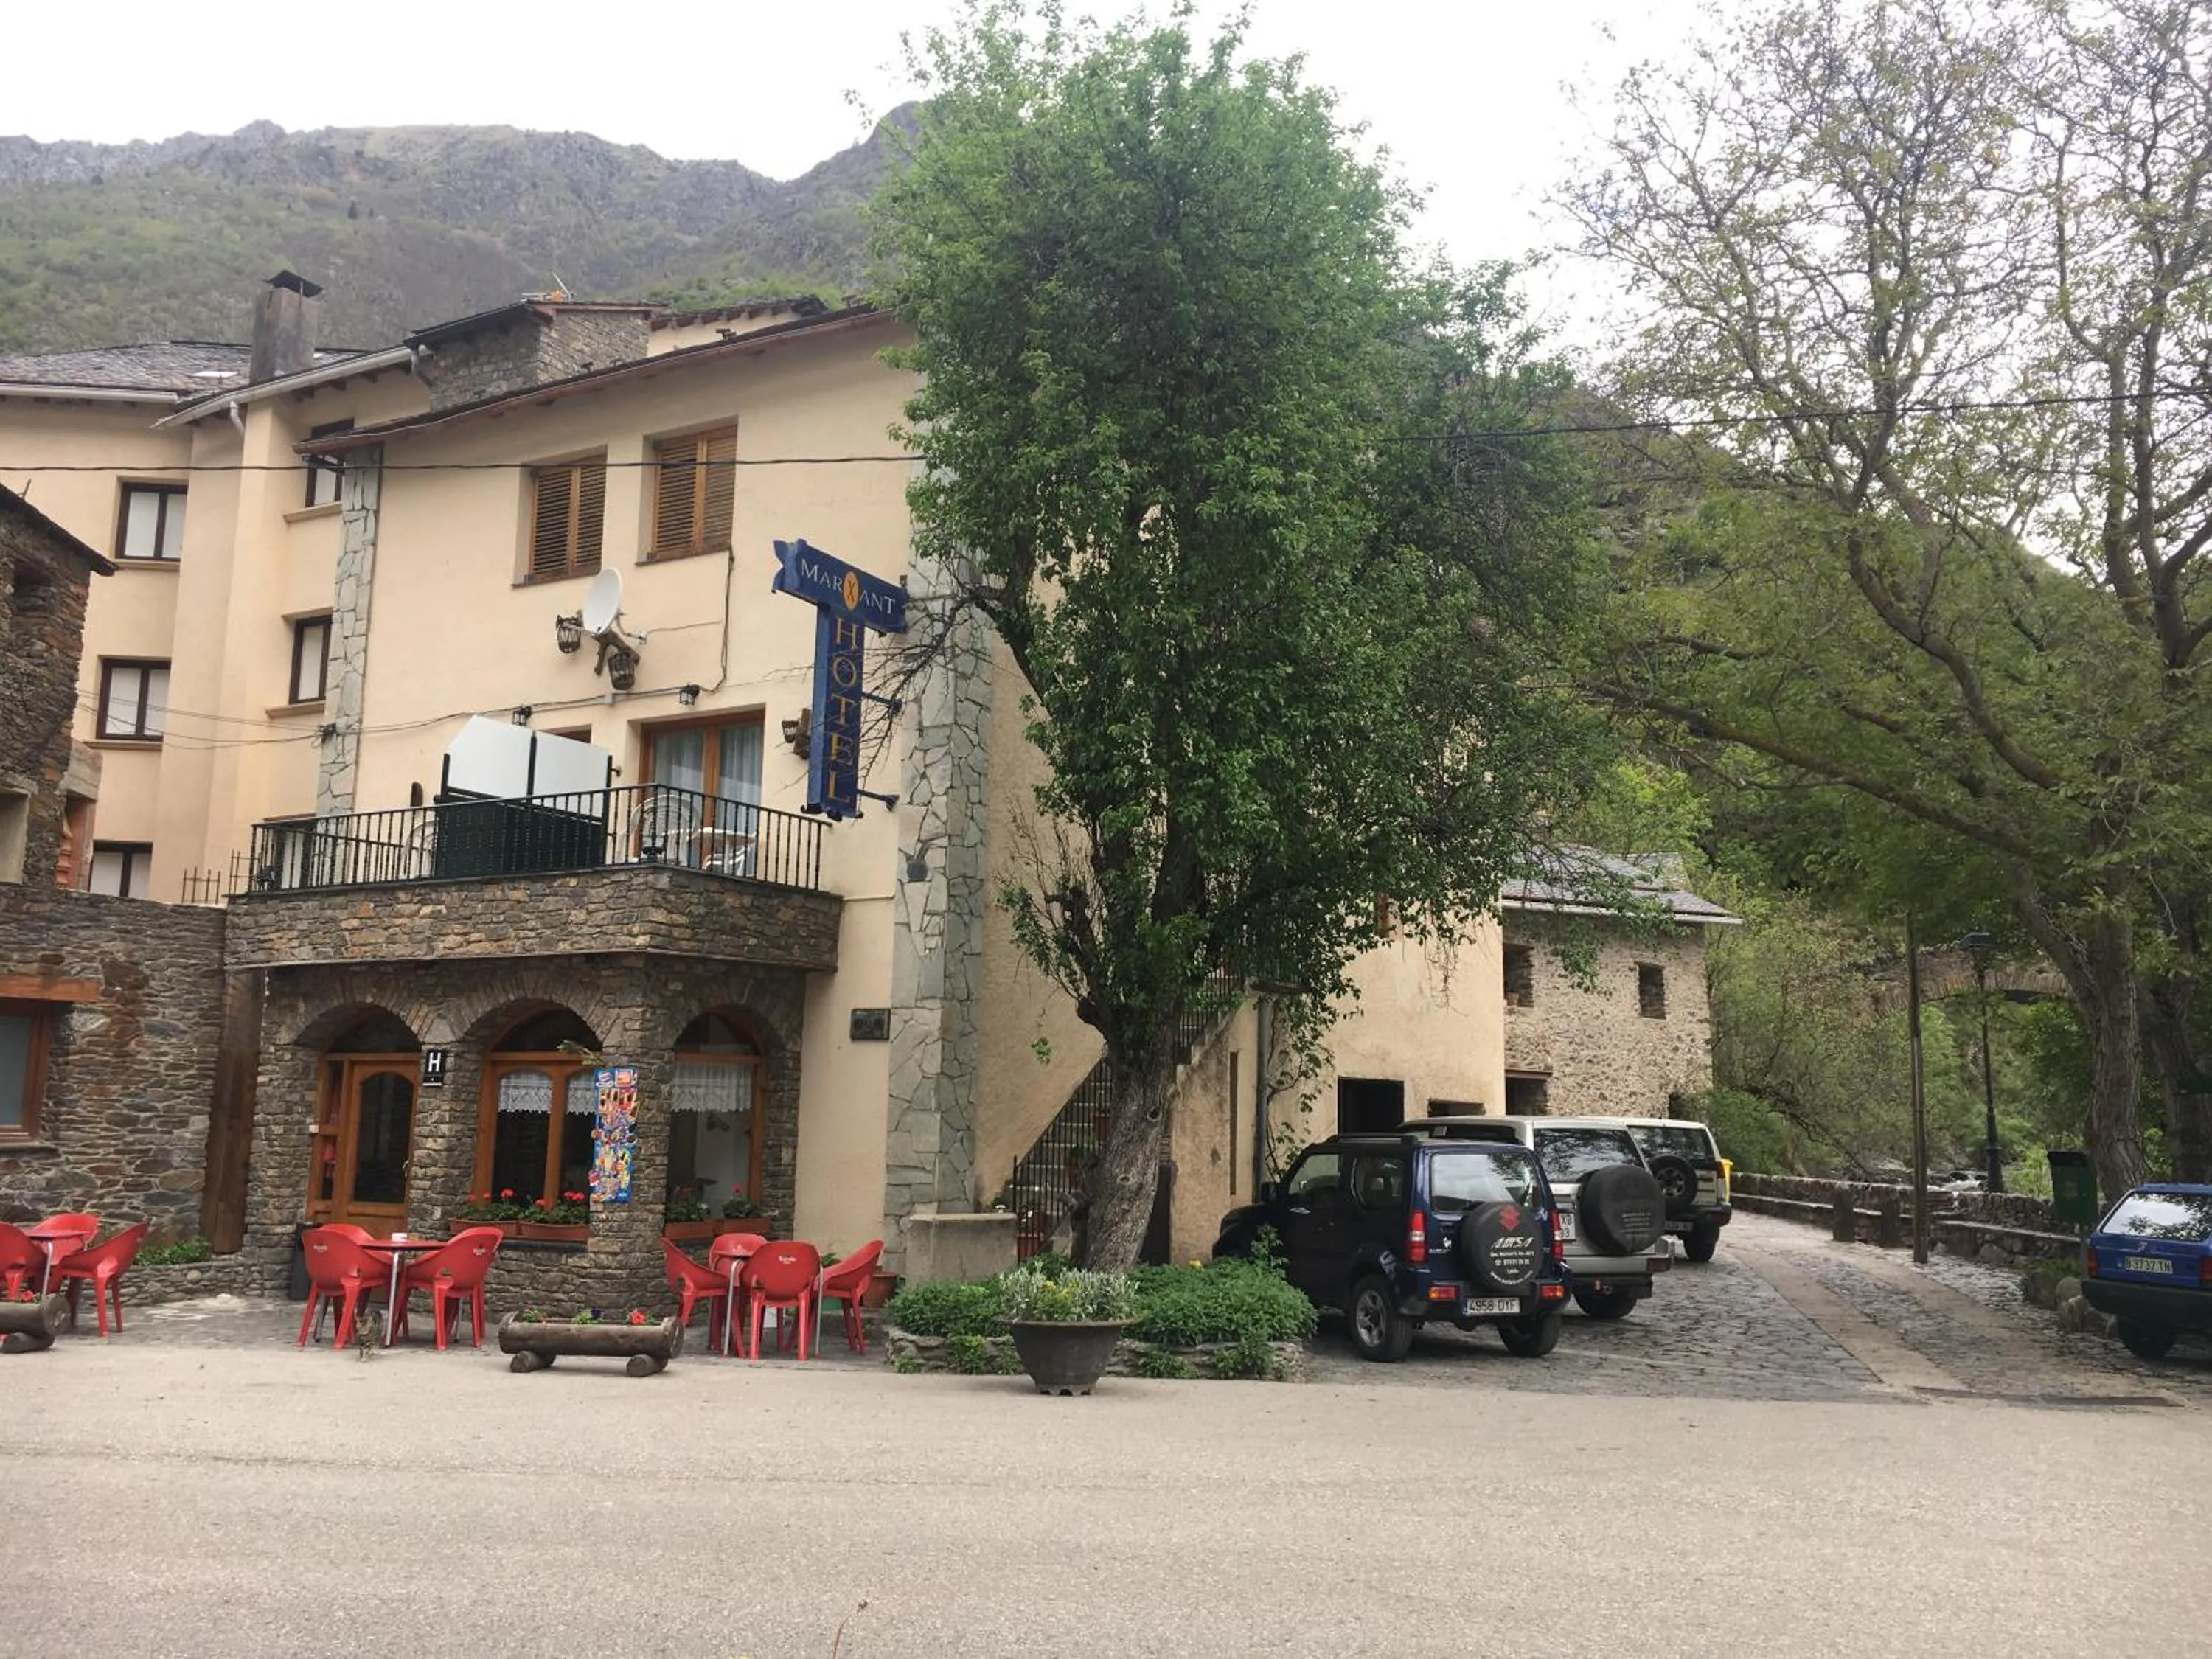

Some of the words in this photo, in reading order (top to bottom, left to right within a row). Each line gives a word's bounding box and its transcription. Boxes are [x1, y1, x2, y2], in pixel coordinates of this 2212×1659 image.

[828, 616, 860, 802] HOTEL
[428, 1051, 442, 1072] H
[1469, 1299, 1495, 1312] 4958
